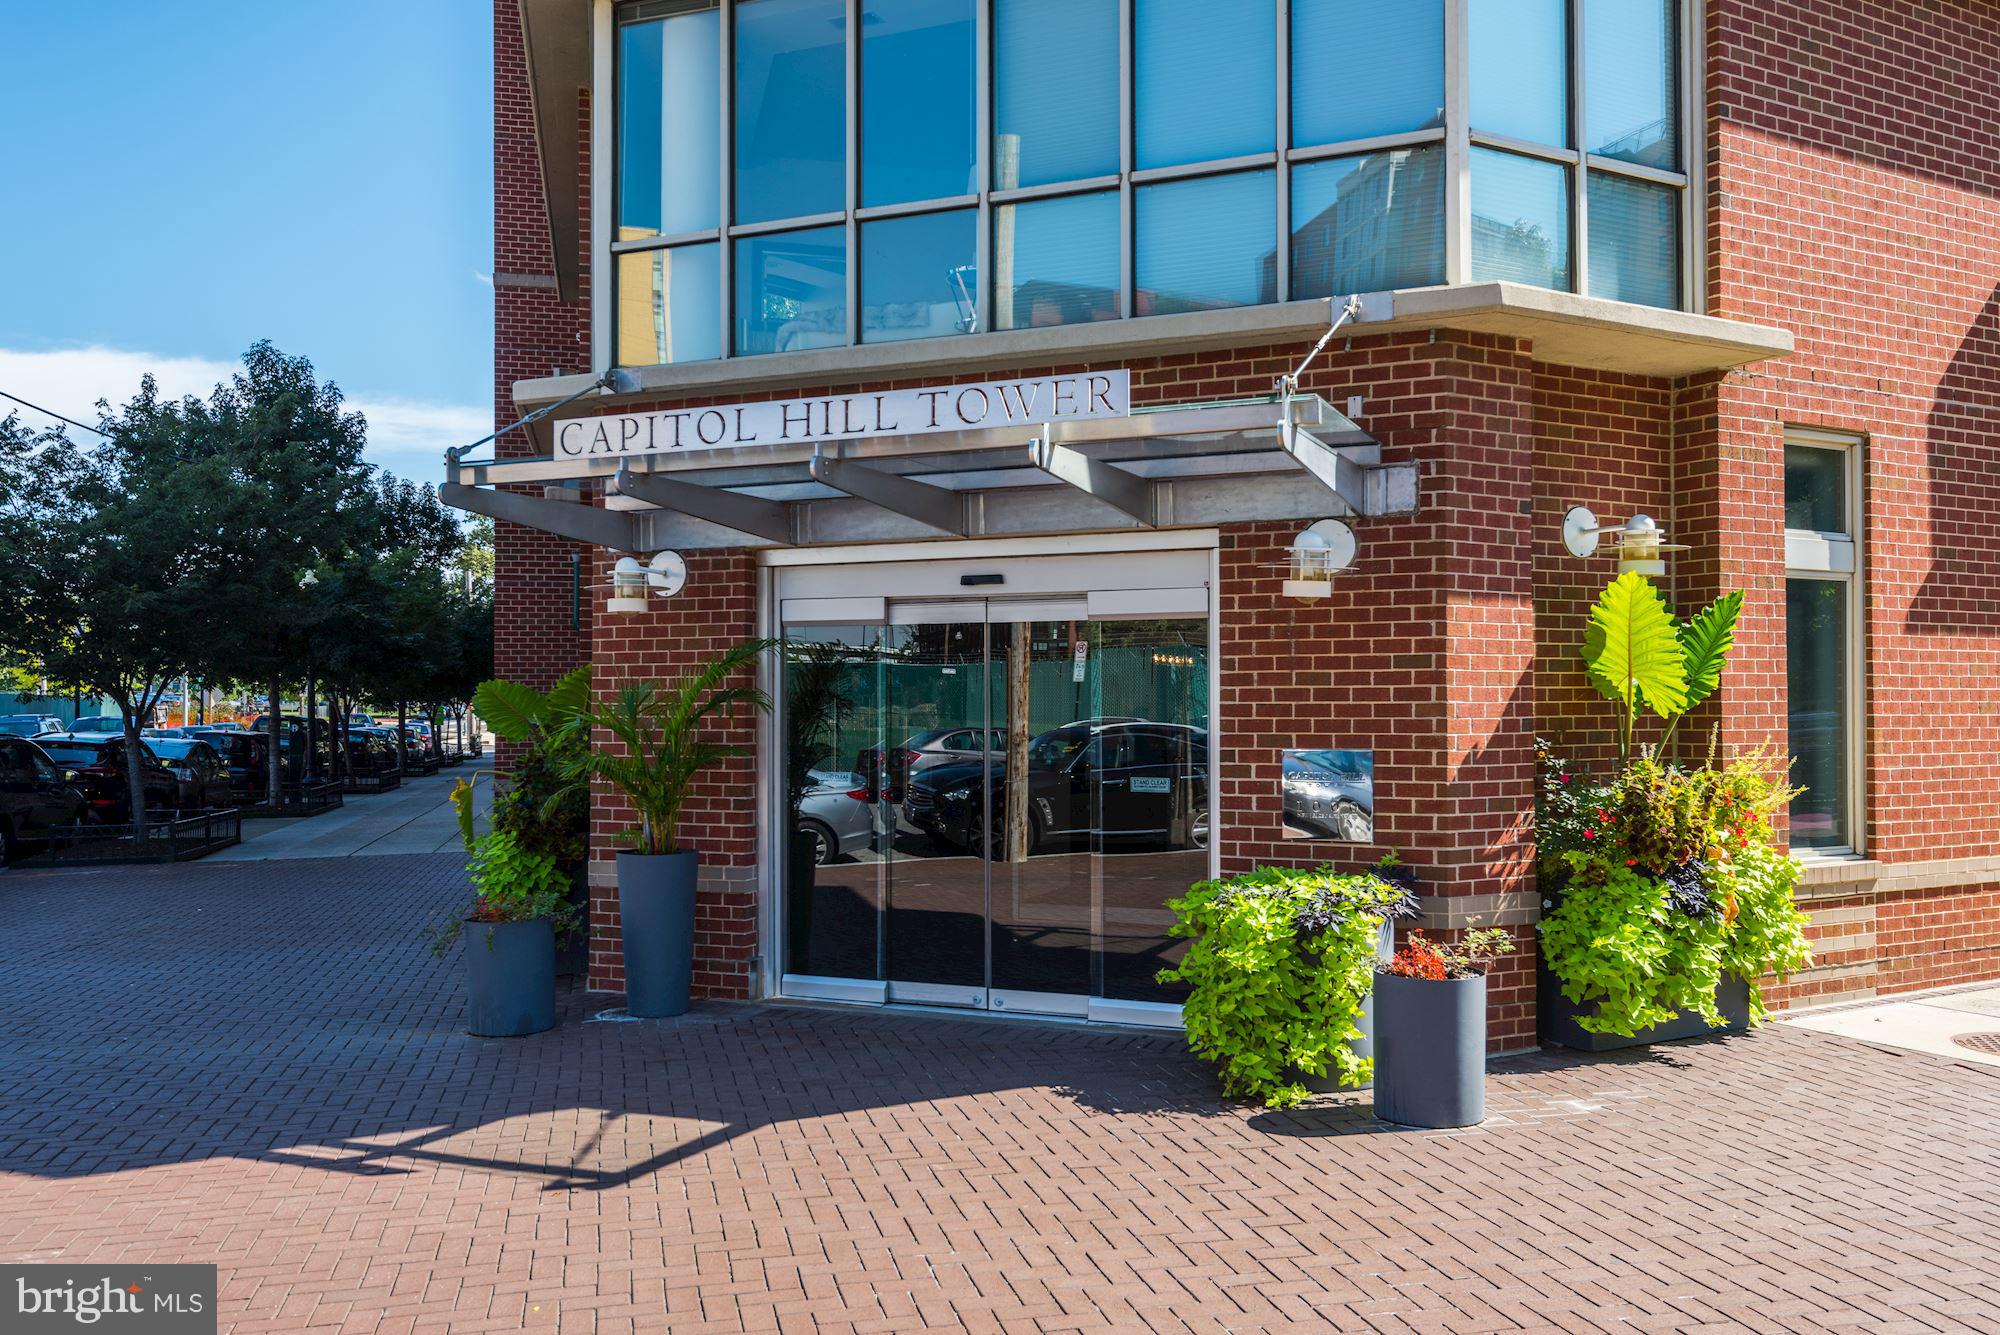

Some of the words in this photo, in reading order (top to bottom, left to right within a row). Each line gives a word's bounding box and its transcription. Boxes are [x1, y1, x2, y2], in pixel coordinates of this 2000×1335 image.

[560, 408, 757, 456] CAPITOL
[780, 396, 898, 439] HILL
[917, 376, 1120, 427] TOWER
